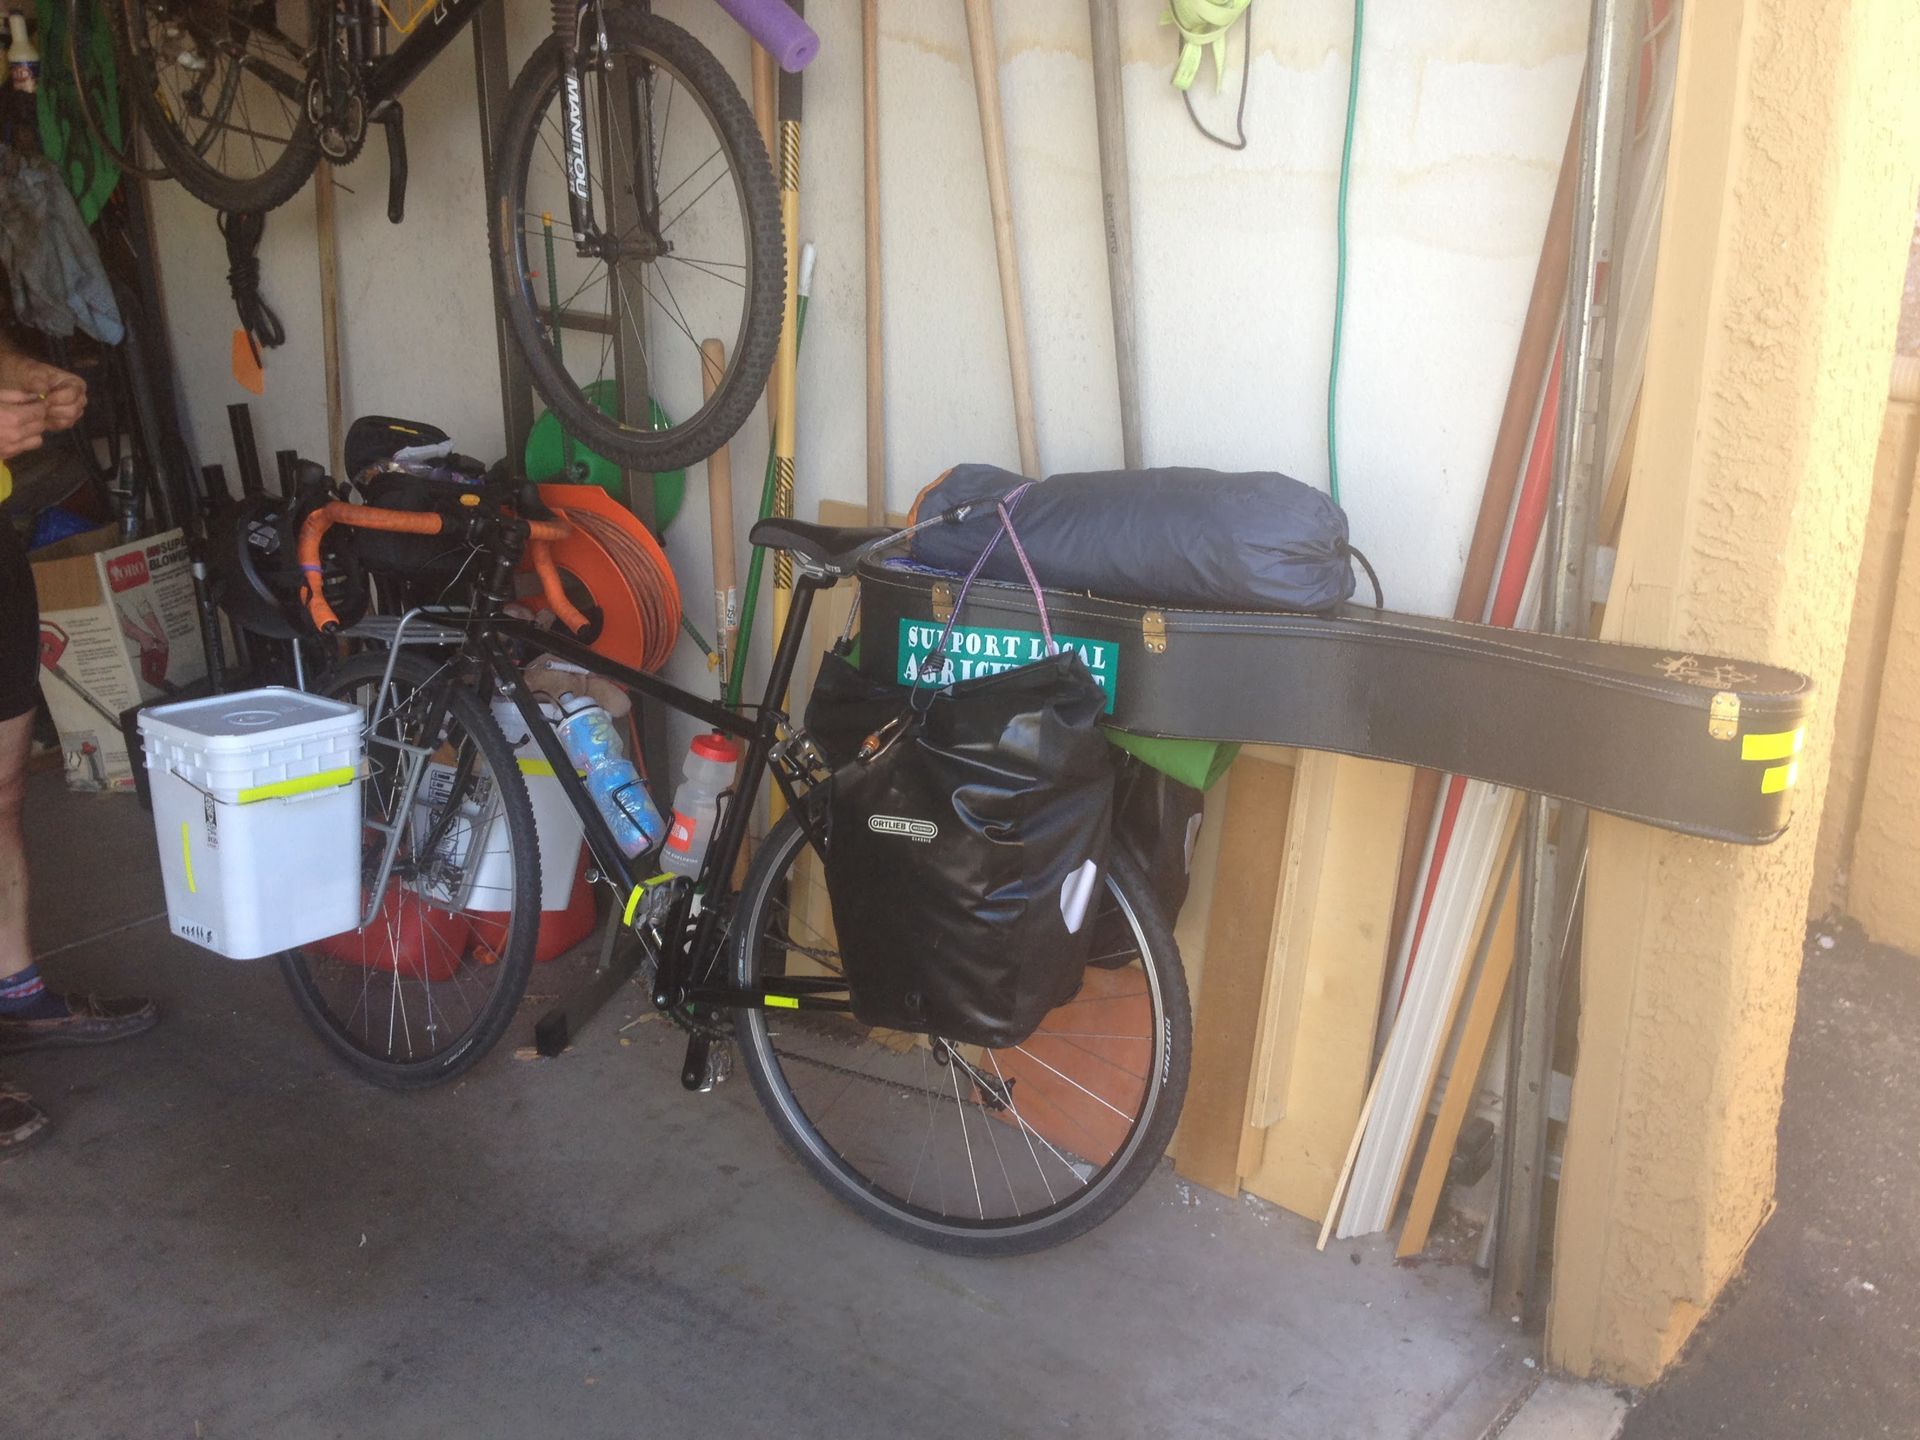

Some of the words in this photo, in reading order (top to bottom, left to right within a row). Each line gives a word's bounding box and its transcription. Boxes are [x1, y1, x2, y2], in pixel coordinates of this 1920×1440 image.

[567, 77, 588, 199] MANITOU
[872, 819, 906, 831] ORTLIEB
[1162, 1016, 1172, 1088] RITCHEY
